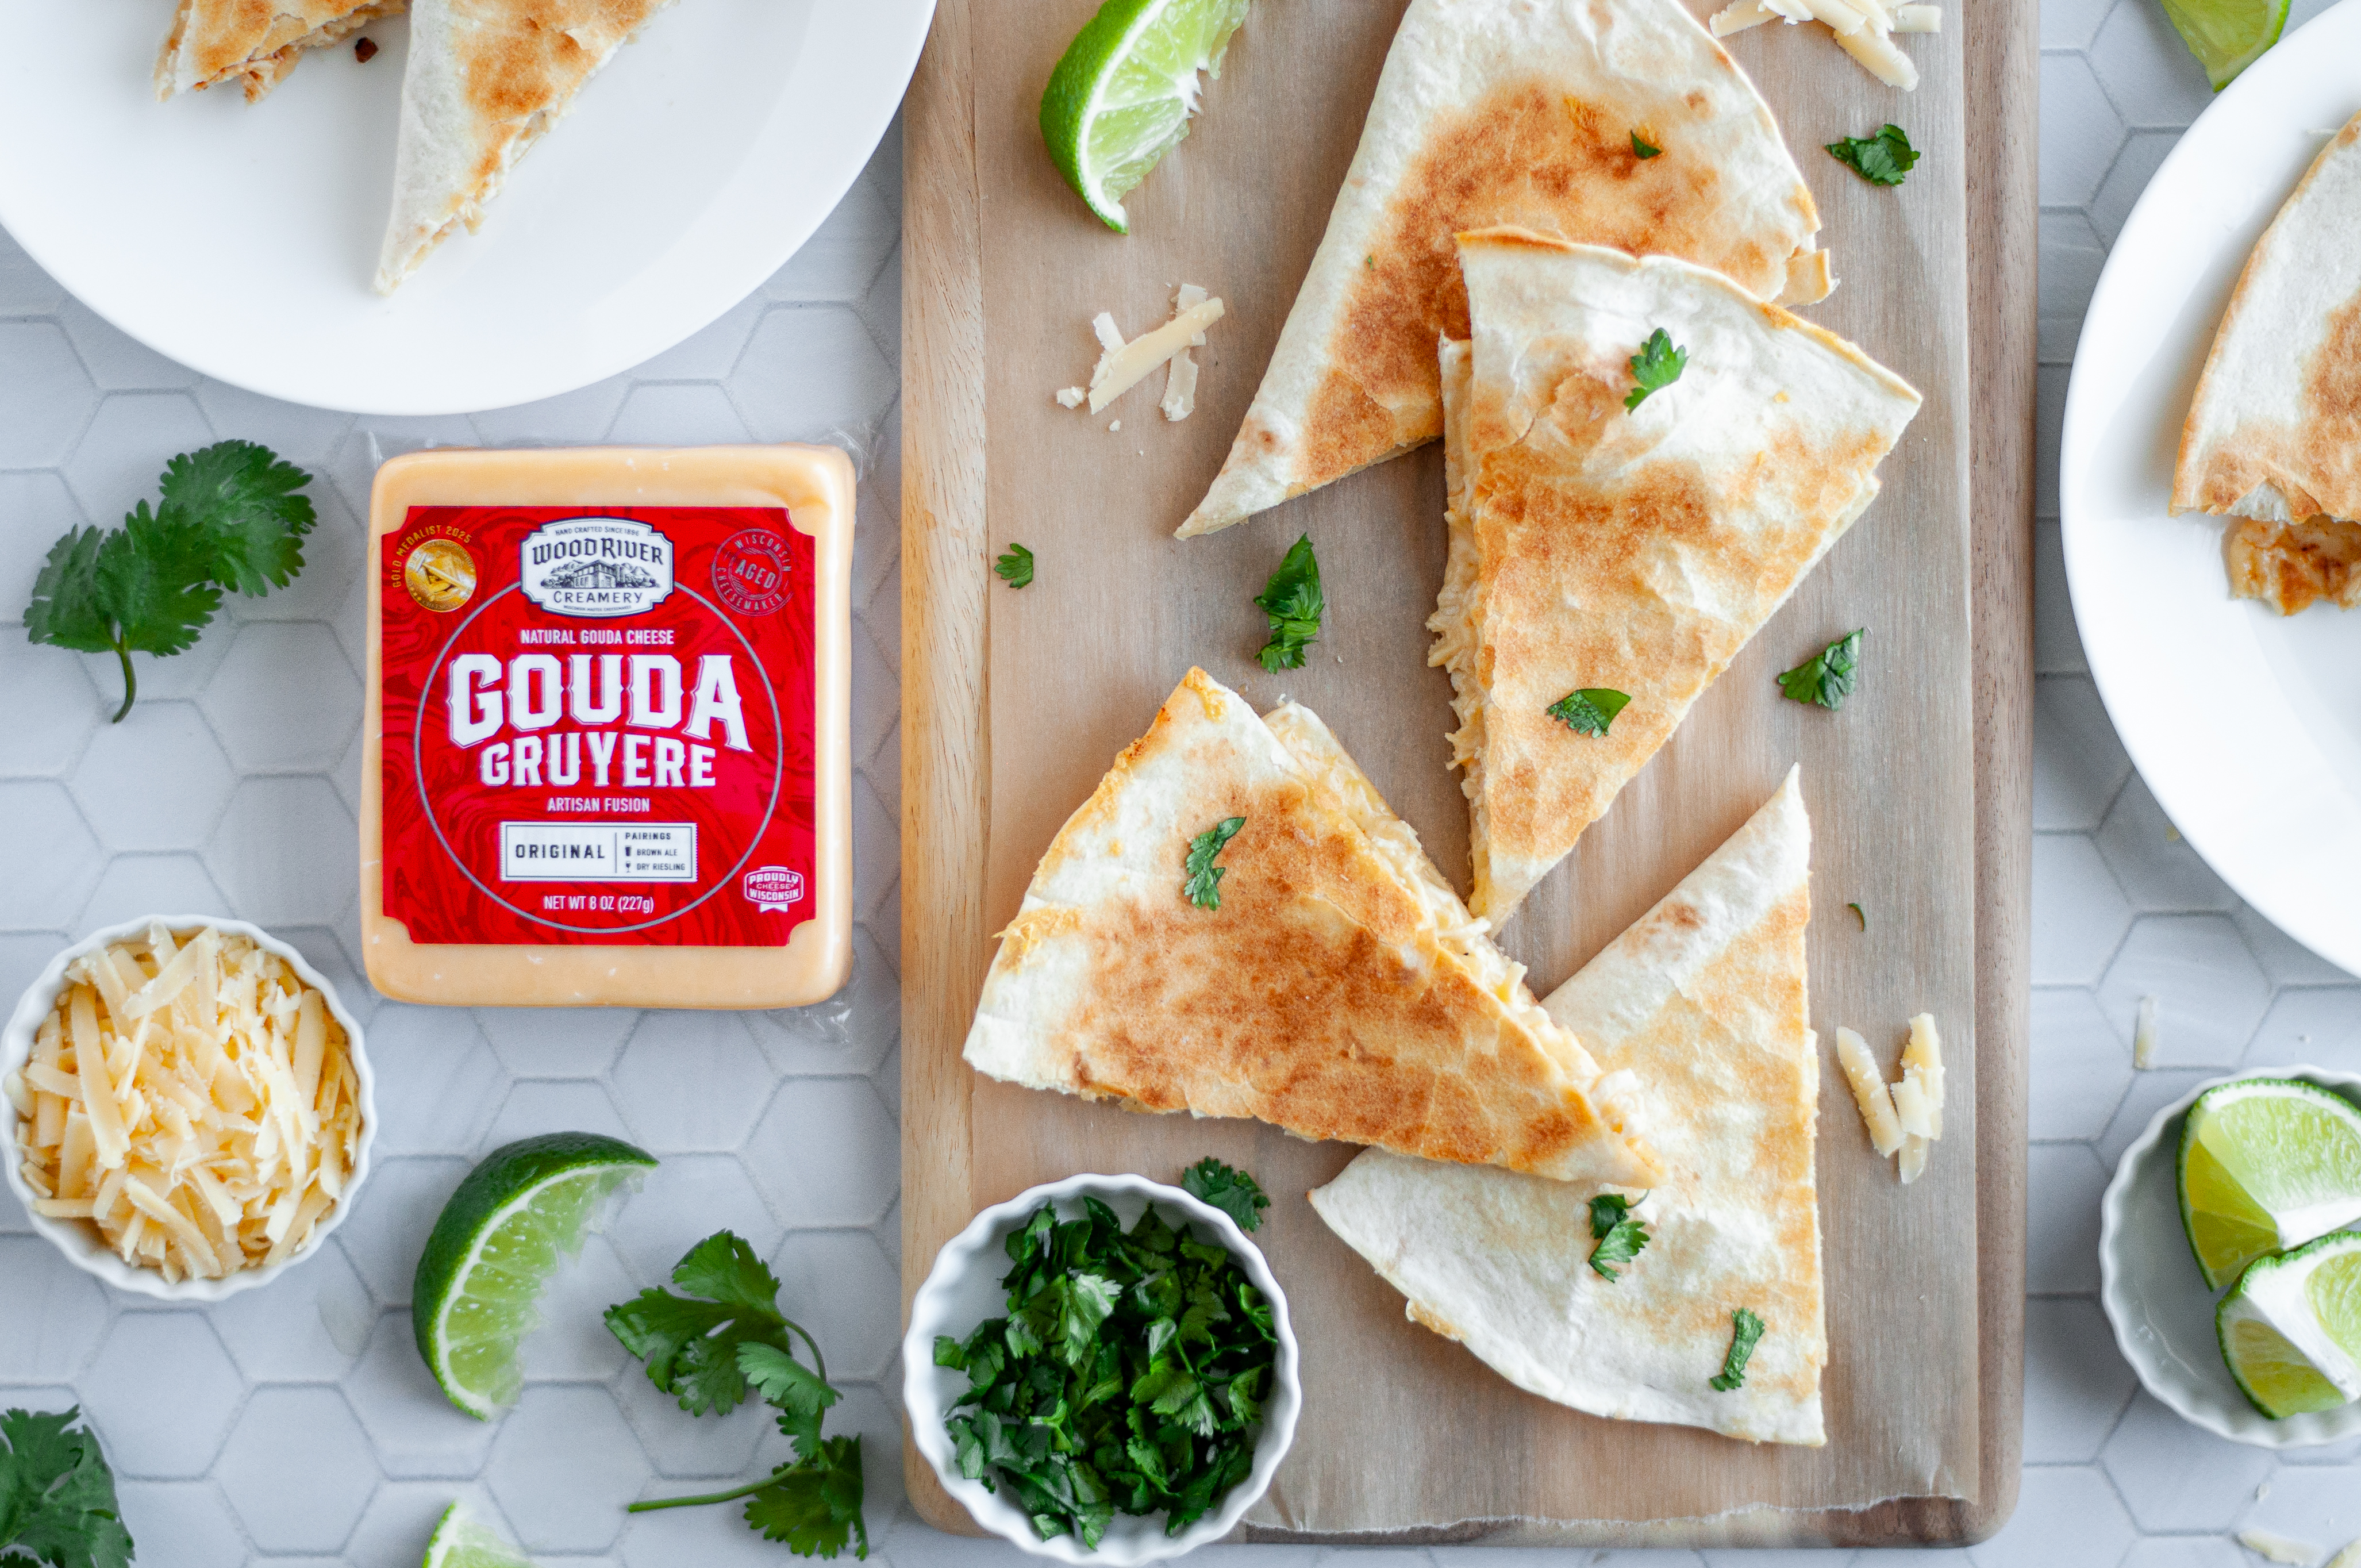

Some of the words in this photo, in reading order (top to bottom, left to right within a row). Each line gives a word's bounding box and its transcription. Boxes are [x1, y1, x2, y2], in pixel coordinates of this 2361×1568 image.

[734, 535, 792, 571] WISCONSIN
[735, 559, 776, 589] AGED
[553, 590, 643, 603] CREAMERY
[520, 629, 576, 645] NATURAL
[580, 629, 622, 645] GOUDA
[625, 629, 675, 645] CHEESE
[446, 654, 753, 752] GOUDA
[479, 731, 716, 787] GRUYERE
[547, 797, 599, 813] ARTISAN
[603, 797, 650, 812] FUSION
[516, 844, 605, 859] ORIGINAL
[637, 848, 662, 856] BROWN
[749, 873, 799, 885] PROUDLY
[749, 887, 799, 901] WISCONSIN
[544, 896, 566, 910] NET
[568, 896, 587, 910] WT
[589, 896, 597, 910] 8
[600, 896, 614, 910] OZ
[617, 896, 655, 914] (227g)
